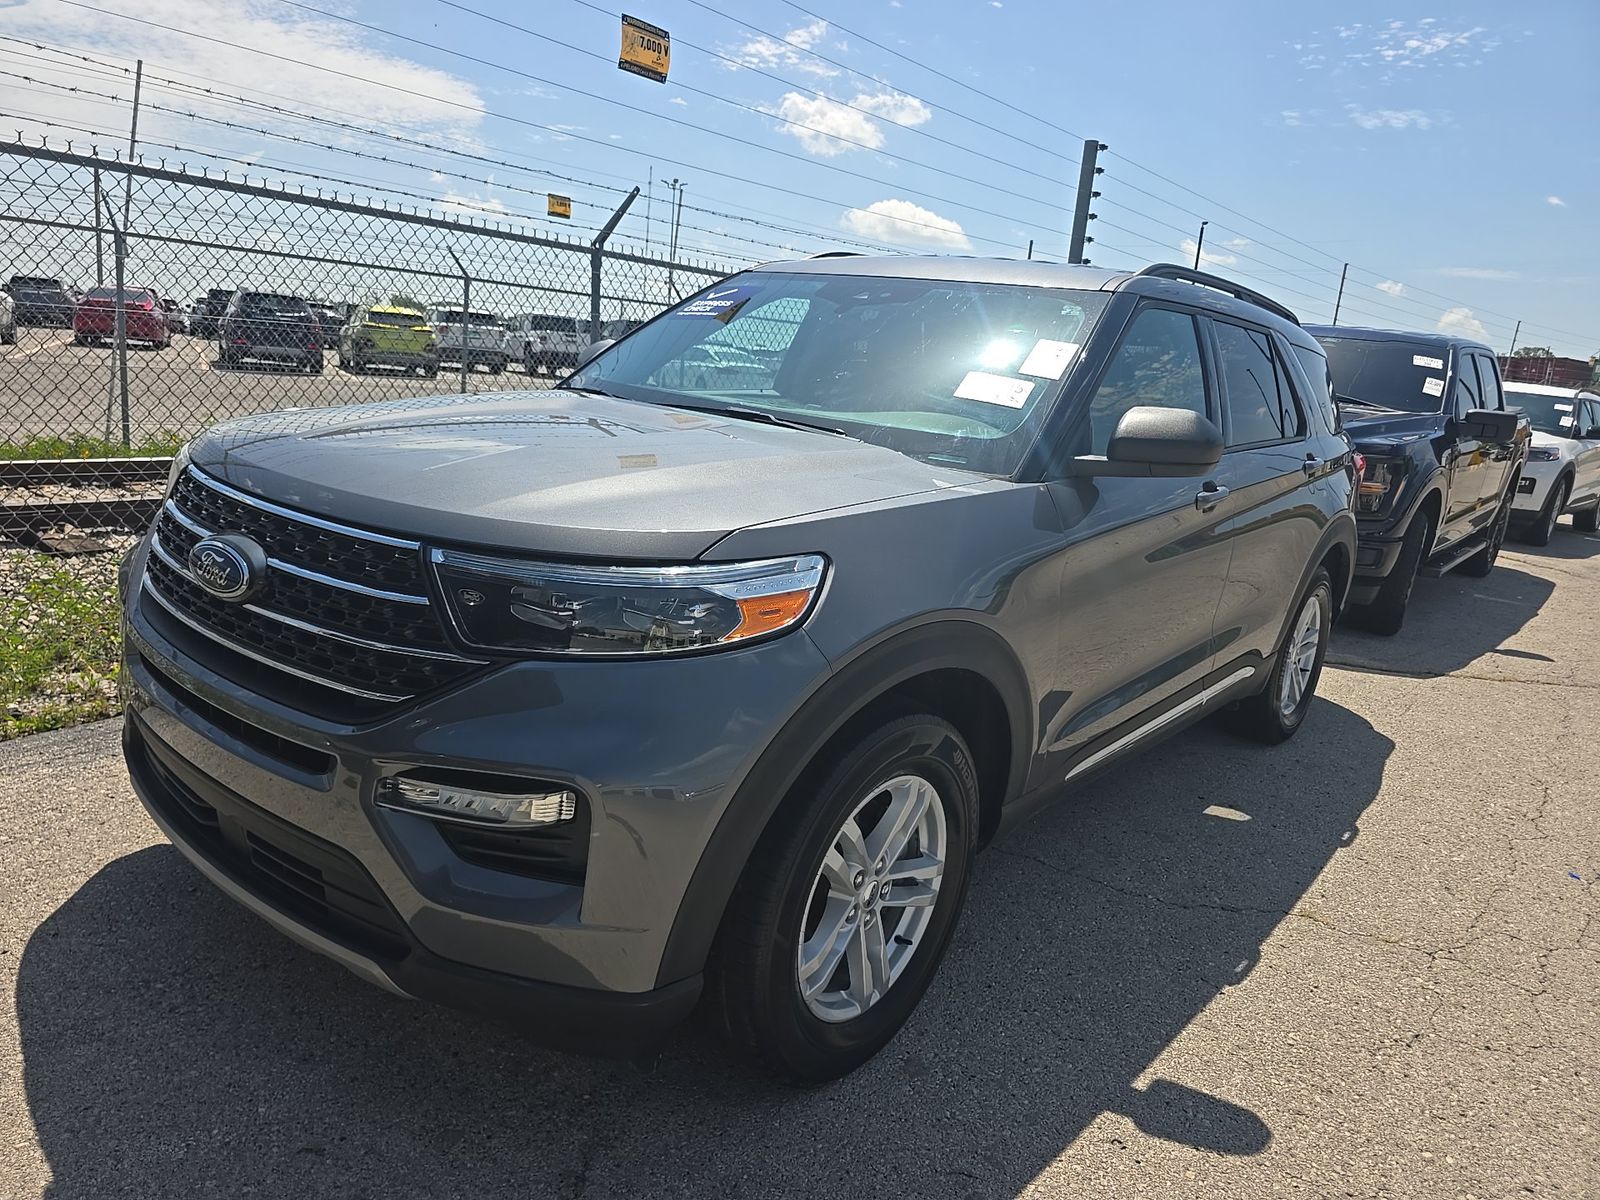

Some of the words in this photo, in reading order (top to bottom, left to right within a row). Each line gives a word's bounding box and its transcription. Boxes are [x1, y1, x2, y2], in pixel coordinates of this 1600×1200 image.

[640, 36, 662, 54] 7,000
[663, 44, 669, 57] V
[196, 550, 231, 586] Ford
